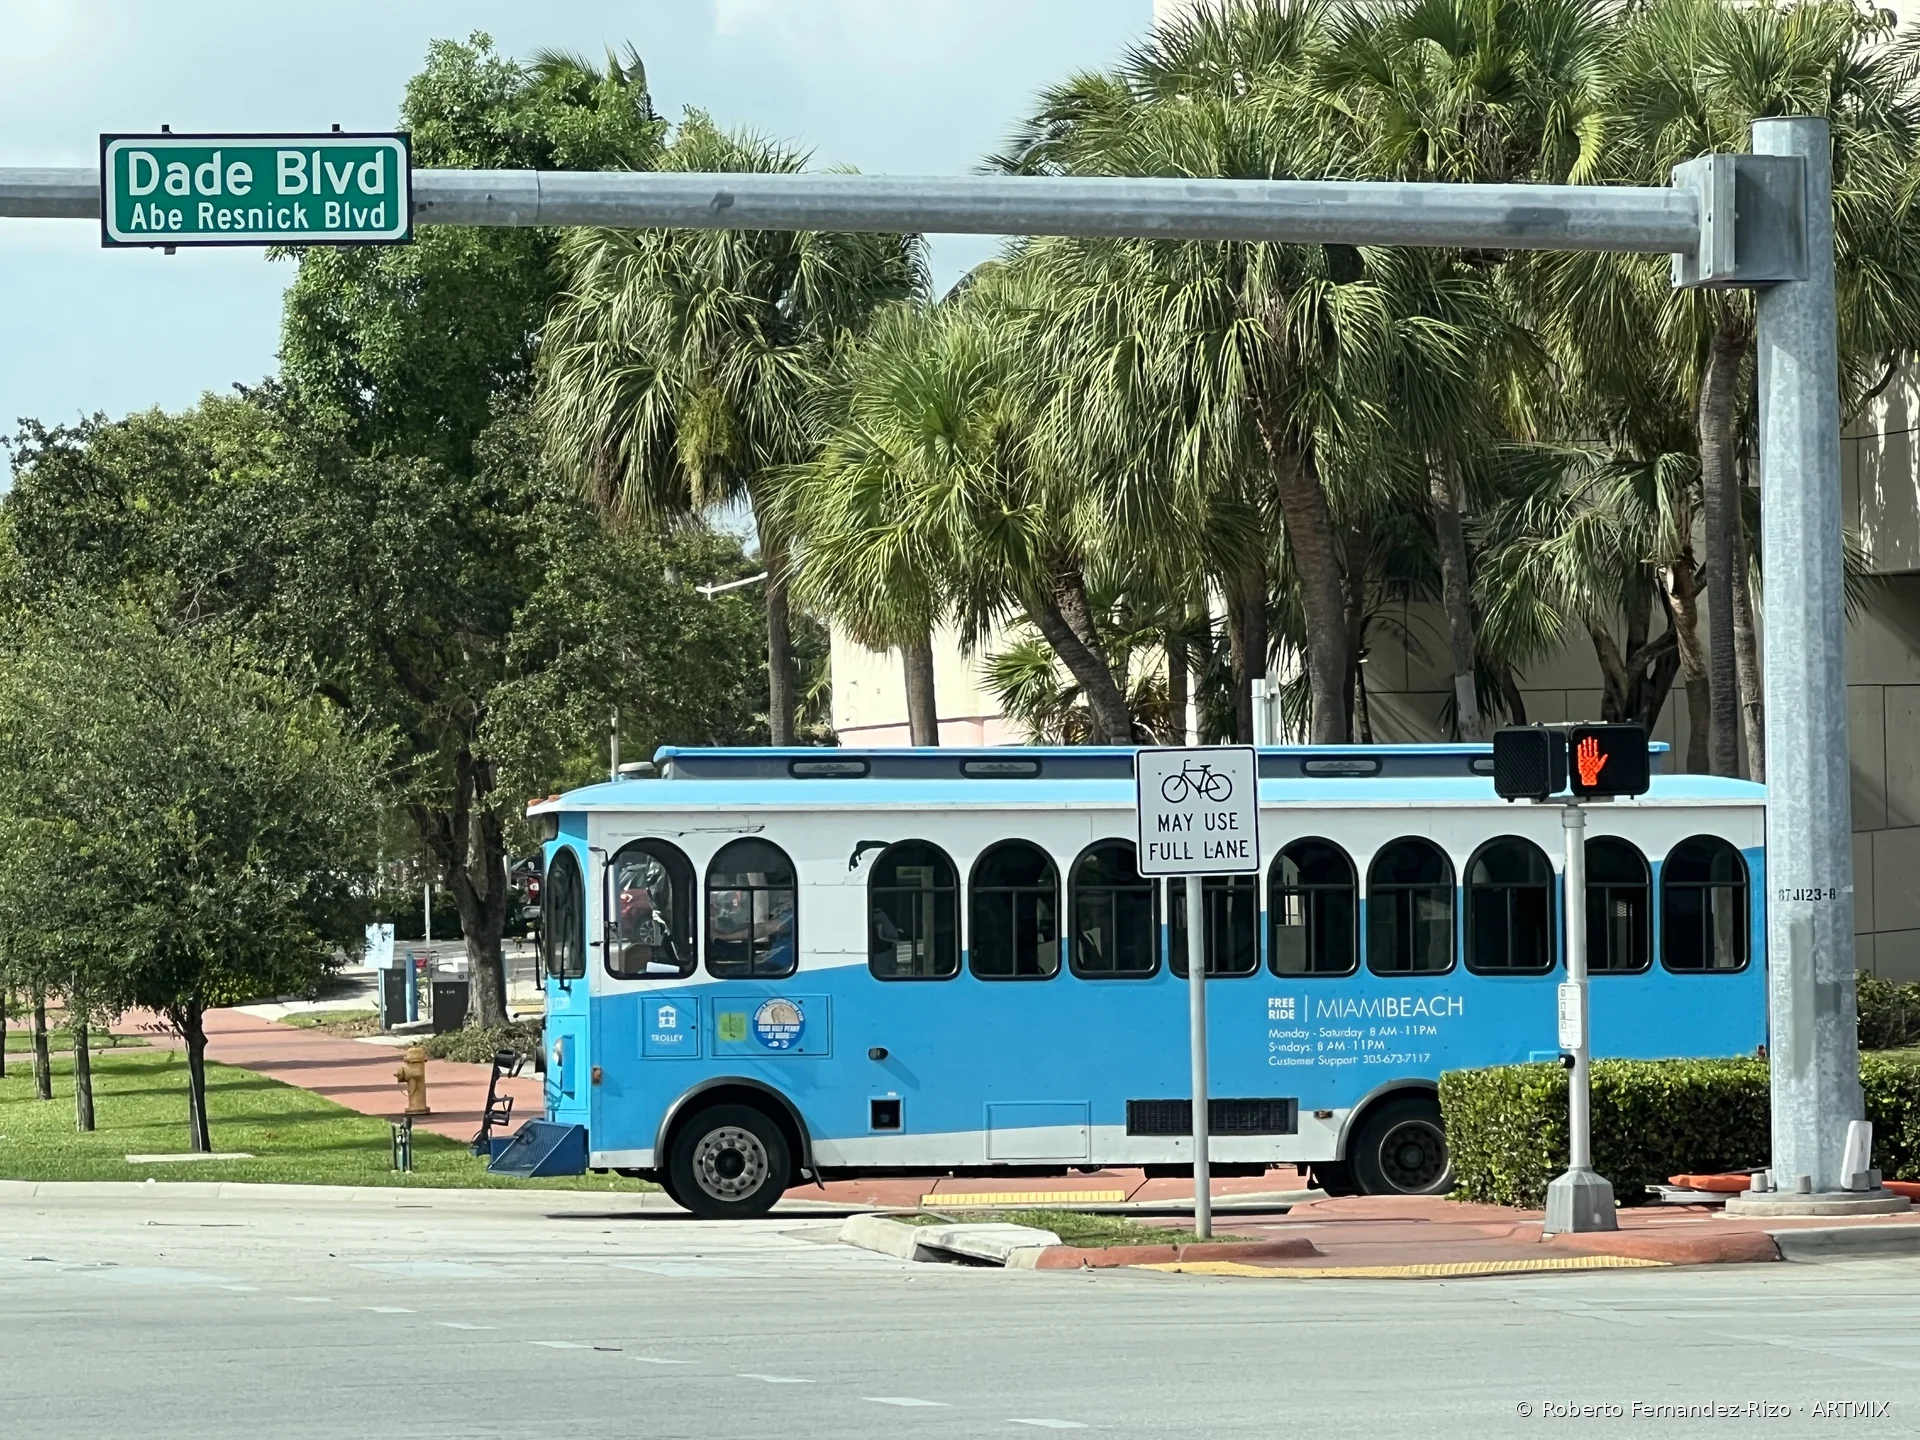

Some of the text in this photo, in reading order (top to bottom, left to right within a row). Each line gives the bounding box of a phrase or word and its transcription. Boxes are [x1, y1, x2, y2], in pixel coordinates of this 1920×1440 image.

[128, 149, 385, 196] Dade Blvd
[130, 200, 386, 230] Abe Resnick Blvd
[1158, 812, 1239, 832] MAY USE
[1149, 839, 1249, 860] FULL LANE
[1268, 998, 1295, 1008] FREE
[1316, 996, 1463, 1018] MIAMIBEACH
[1268, 1009, 1295, 1020] RIDE
[651, 1034, 683, 1042] TROLLEY
[1268, 1027, 1310, 1040] Monday
[1369, 1027, 1376, 1037] 8
[1317, 1041, 1324, 1052] 8
[1268, 1056, 1315, 1066] Customer
